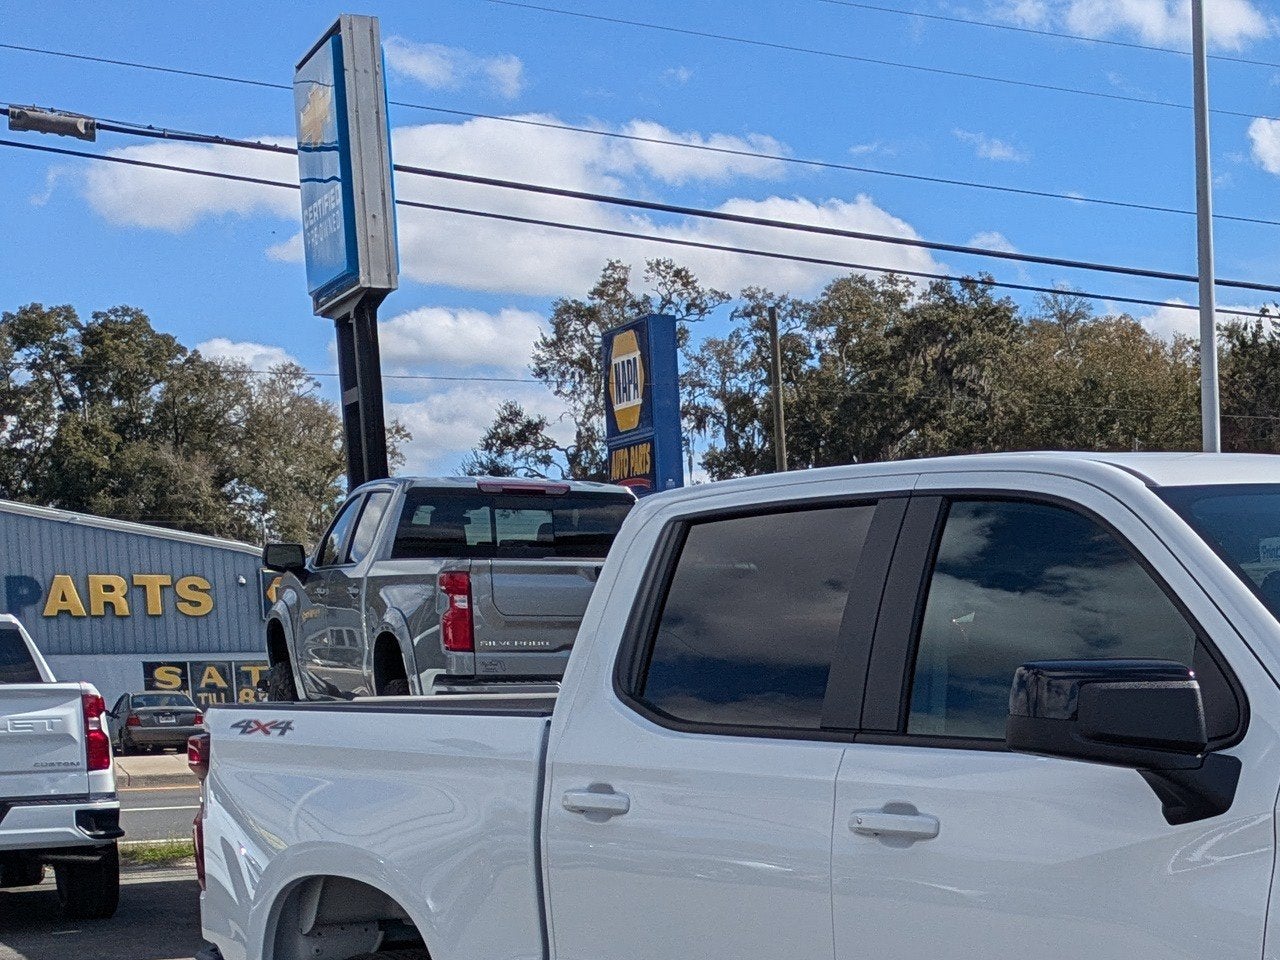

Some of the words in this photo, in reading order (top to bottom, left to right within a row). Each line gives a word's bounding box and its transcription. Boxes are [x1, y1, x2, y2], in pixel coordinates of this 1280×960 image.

[613, 356, 639, 406] NAPA
[611, 448, 629, 481] AUTO
[630, 442, 651, 477] PARTS
[4, 573, 215, 617] PARTS
[33, 760, 81, 768] CUSTOM
